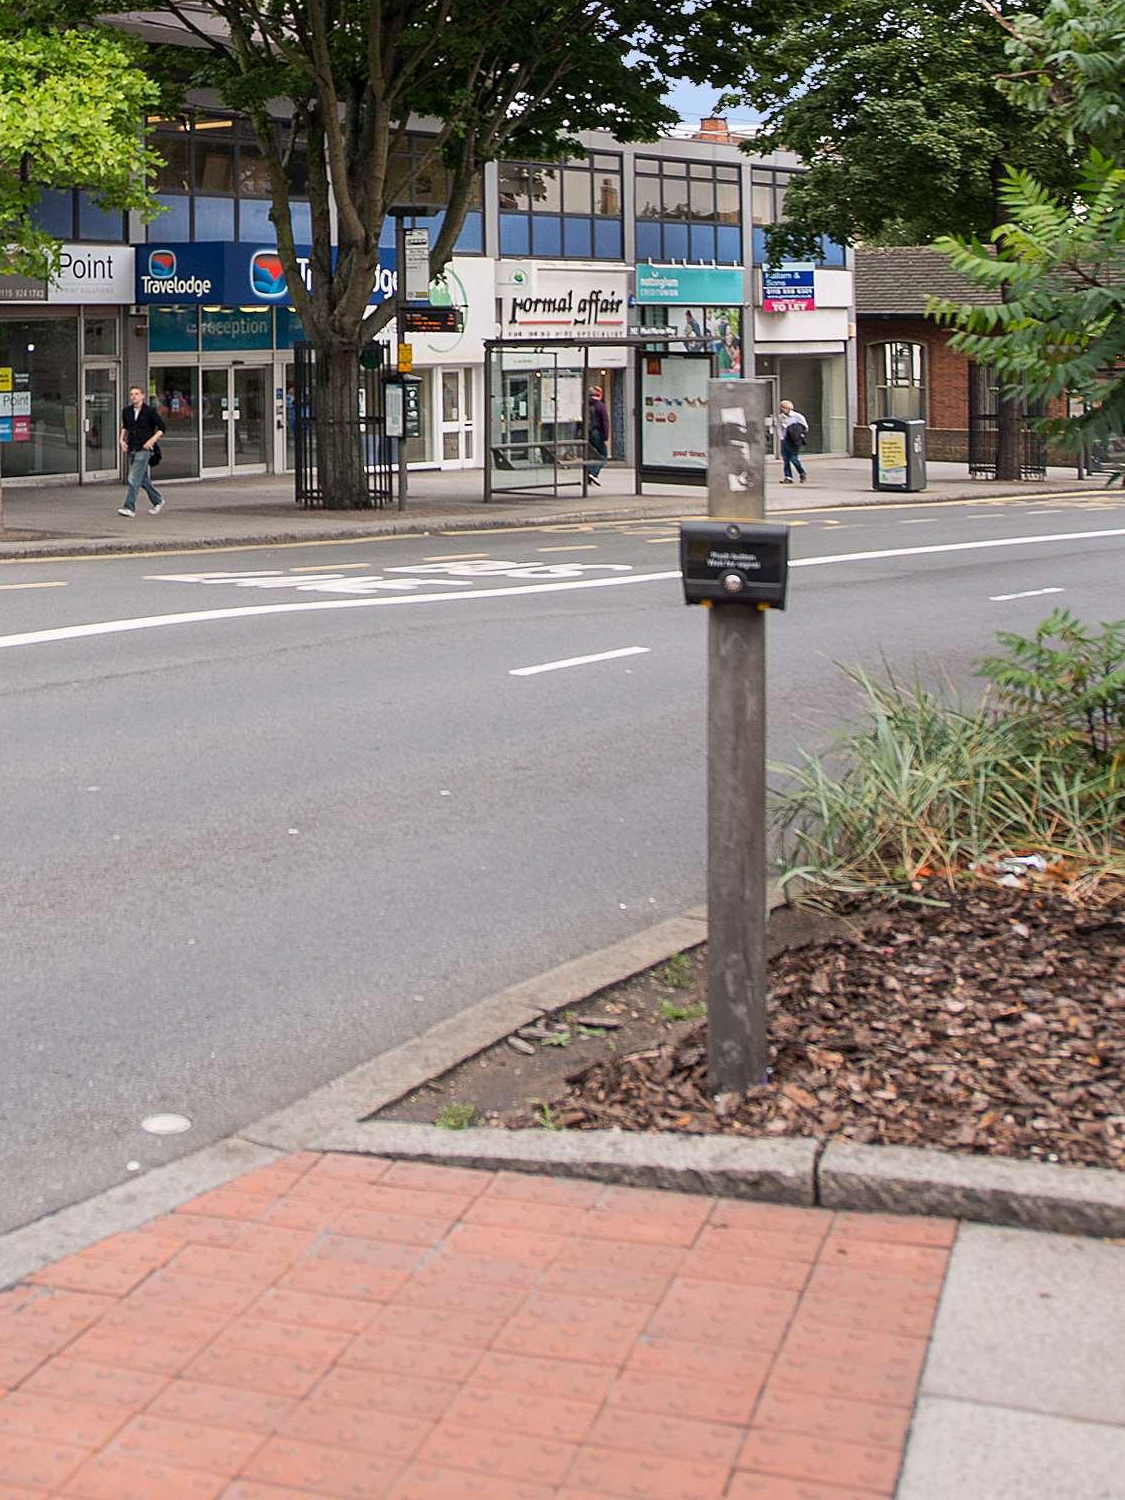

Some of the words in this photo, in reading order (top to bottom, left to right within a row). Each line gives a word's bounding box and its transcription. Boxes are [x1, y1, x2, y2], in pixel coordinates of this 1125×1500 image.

[58, 253, 114, 279] Point
[141, 276, 212, 297] Travelodge
[577, 290, 624, 325] affair
[771, 303, 786, 312] TO
[788, 303, 807, 311] LET
